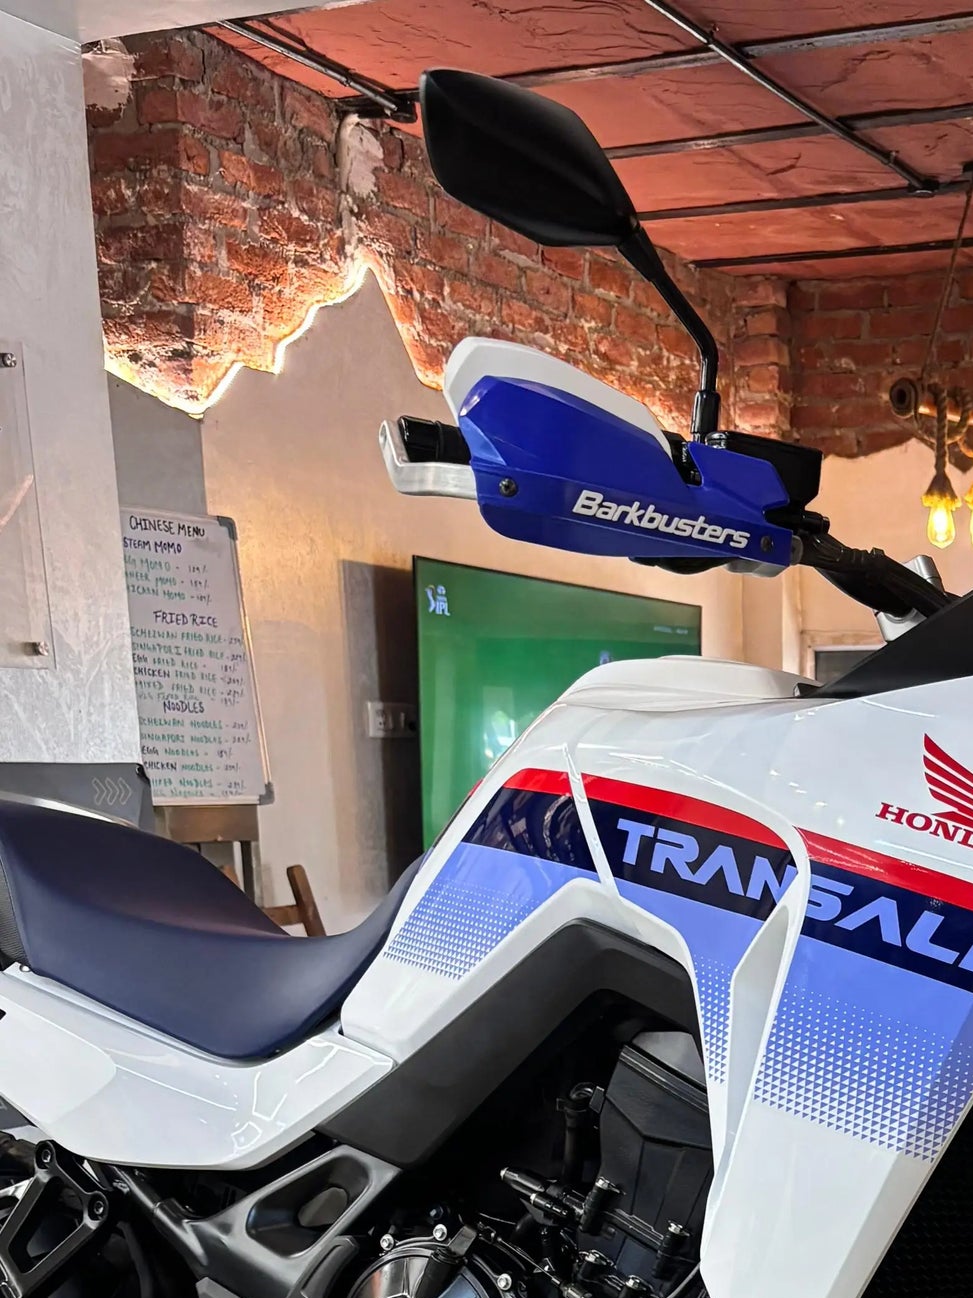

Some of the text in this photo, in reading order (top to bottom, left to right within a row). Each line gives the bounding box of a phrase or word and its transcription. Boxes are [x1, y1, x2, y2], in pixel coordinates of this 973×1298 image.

[572, 489, 750, 549] Barkbusters
[129, 515, 205, 537] CHINESE MENU
[123, 536, 182, 554] STEAM MOMO
[435, 601, 451, 616] IPL
[153, 610, 218, 628] FRIED RICE
[181, 631, 203, 642] FRIED
[205, 634, 222, 644] RICE
[132, 653, 148, 663] EGG
[133, 667, 170, 679] CHICKEN
[171, 683, 195, 694] FRIED
[163, 700, 205, 714] NOODLES
[190, 720, 222, 730] NOODLES
[190, 735, 222, 744] NOODLES
[142, 745, 159, 756] EGG
[164, 747, 199, 757] NOODLES
[144, 761, 177, 771] CHICKEN
[181, 763, 213, 772] NOODLES
[179, 778, 213, 788] NOODLES
